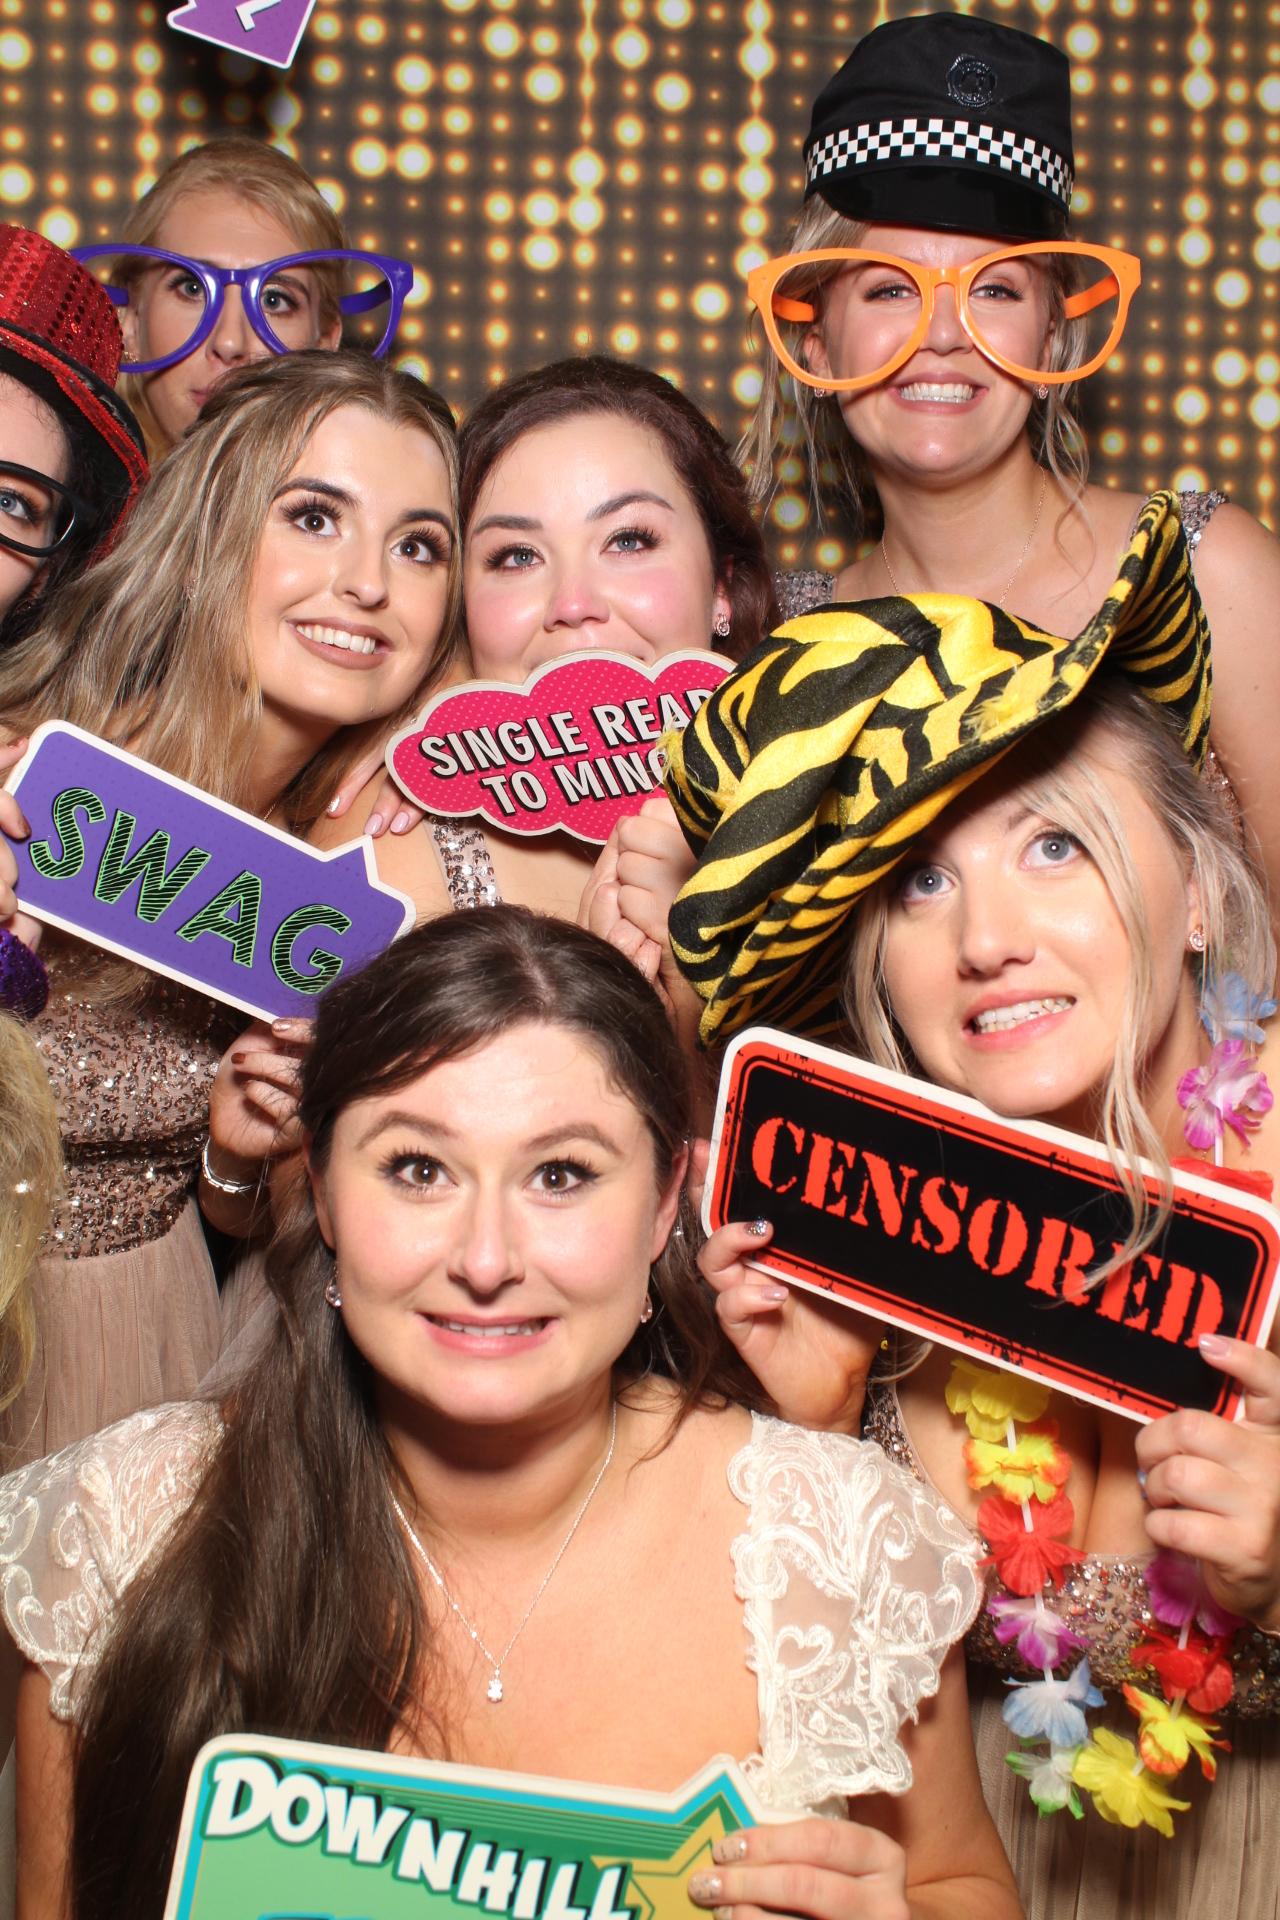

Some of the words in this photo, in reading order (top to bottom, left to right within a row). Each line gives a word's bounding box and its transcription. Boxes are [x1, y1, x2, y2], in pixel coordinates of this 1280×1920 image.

[420, 710, 588, 778] SINGLE
[481, 769, 548, 815] TO
[29, 787, 353, 994] SWAG
[751, 1117, 1225, 1350] CENSORED
[204, 1755, 636, 1920] DOWNHILL
